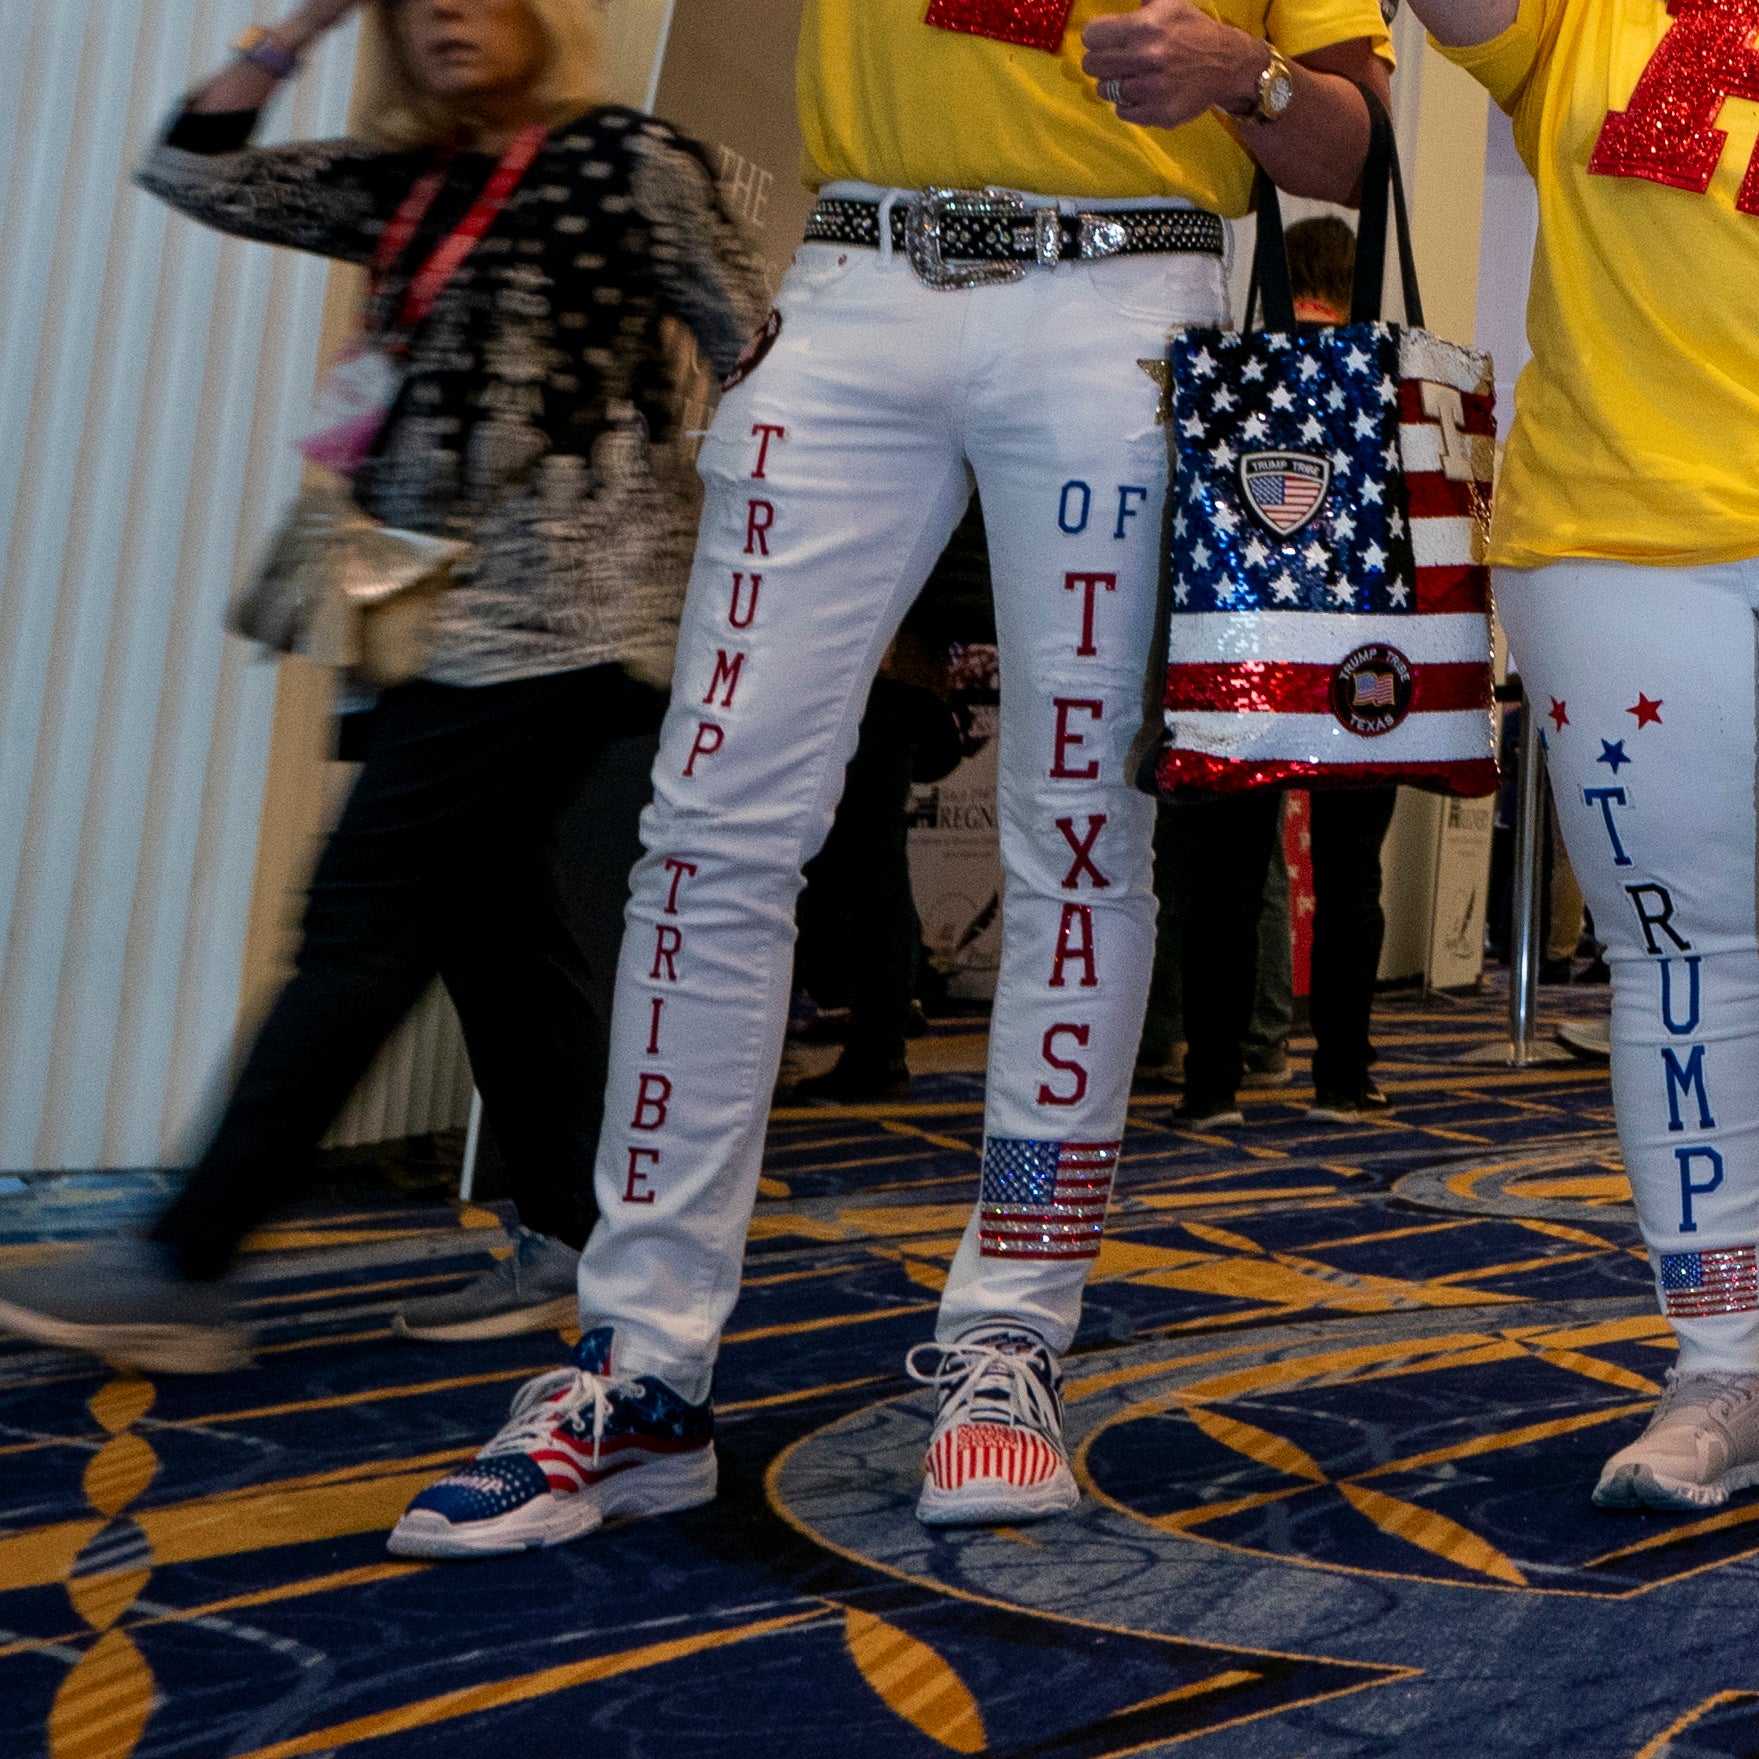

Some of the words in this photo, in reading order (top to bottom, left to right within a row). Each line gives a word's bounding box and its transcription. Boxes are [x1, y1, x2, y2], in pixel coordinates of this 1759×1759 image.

[1057, 480, 1146, 539] OF
[1251, 460, 1288, 472] TRUMP
[683, 422, 789, 778] TRUMP
[1339, 648, 1378, 682] TRUMP
[1350, 712, 1395, 733] TEXAS
[1036, 572, 1118, 1107] TEXAS
[622, 857, 698, 1205] TRIBE
[1584, 786, 1723, 1232] TRUMP
